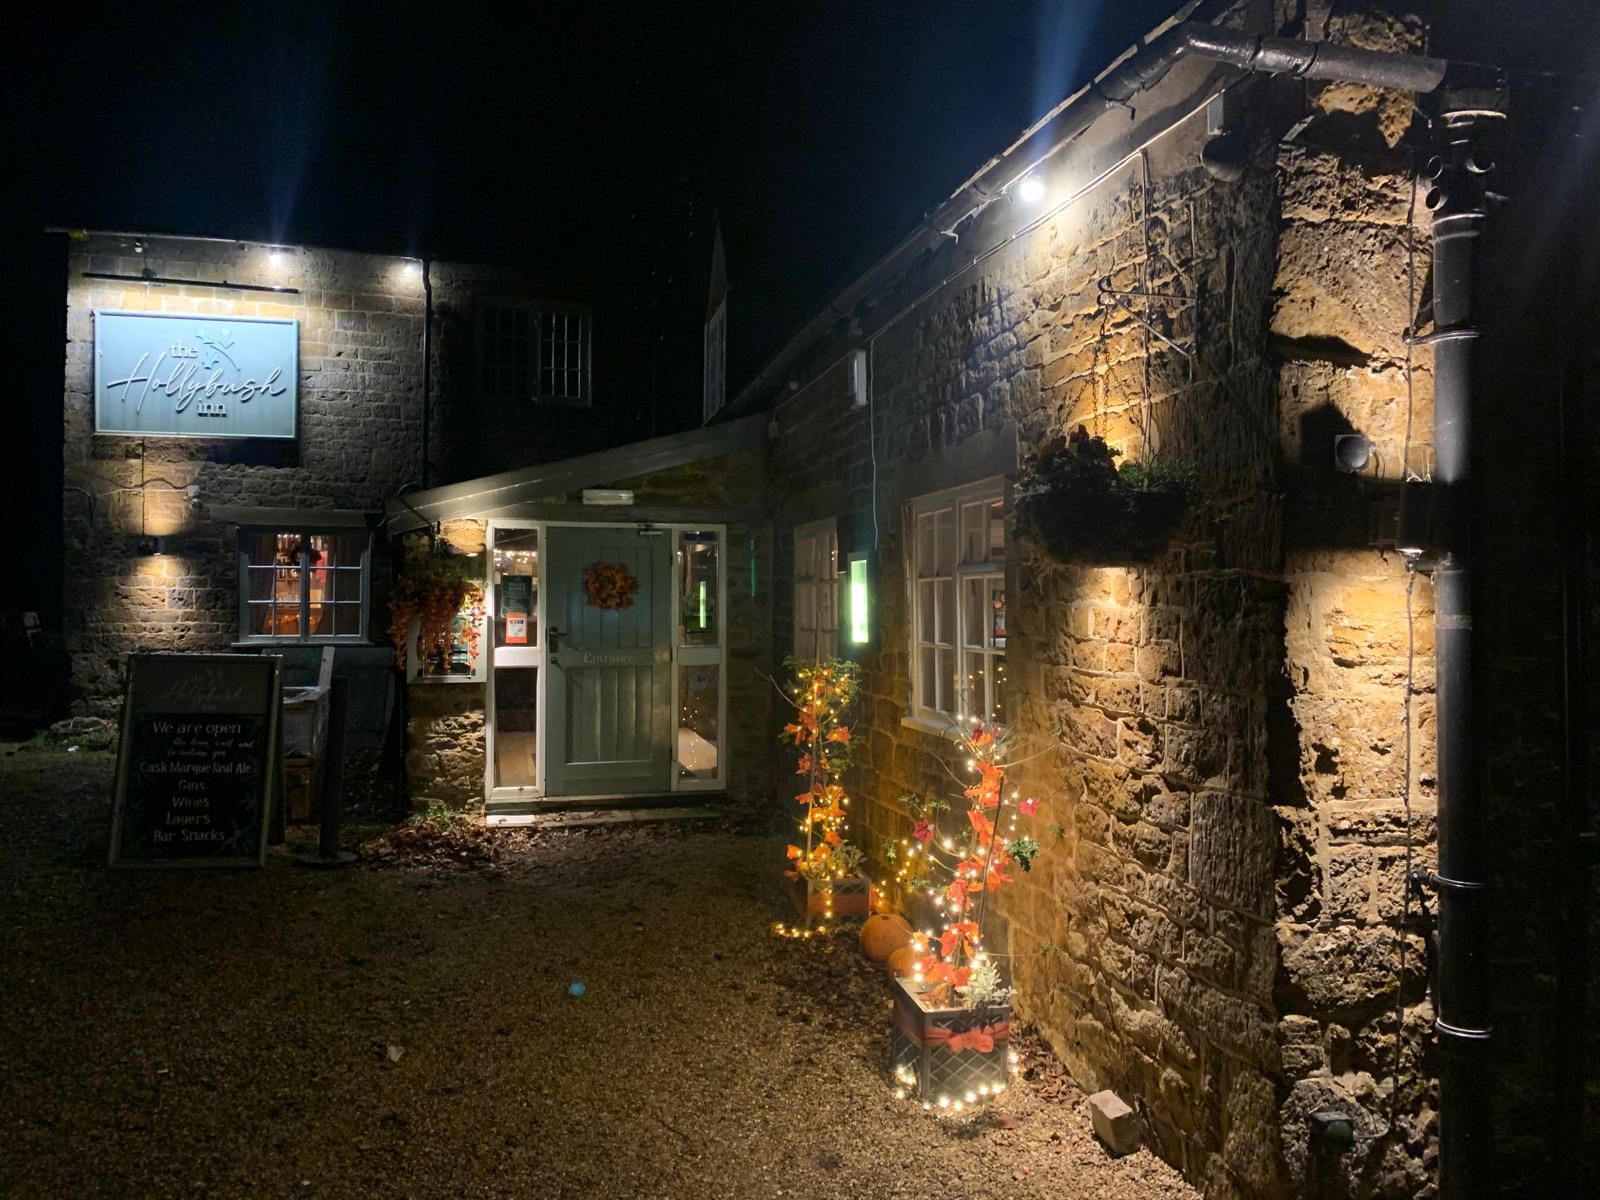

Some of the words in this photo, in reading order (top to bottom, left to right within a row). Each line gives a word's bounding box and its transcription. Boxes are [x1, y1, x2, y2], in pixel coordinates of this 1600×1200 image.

[170, 340, 198, 358] the
[107, 351, 286, 414] Hollybush
[197, 398, 227, 417] inn
[583, 651, 634, 664] Entrance
[152, 720, 174, 734] We
[177, 723, 203, 734] are
[205, 723, 241, 738] open
[139, 761, 168, 774] Cask
[169, 761, 211, 776] Marque
[212, 761, 233, 774] Real
[235, 761, 252, 774] Ale
[178, 779, 206, 791] Gins
[172, 796, 210, 808] Wines
[166, 811, 211, 825] Lagers
[153, 829, 177, 842] Bar
[180, 828, 225, 842] Snacks
